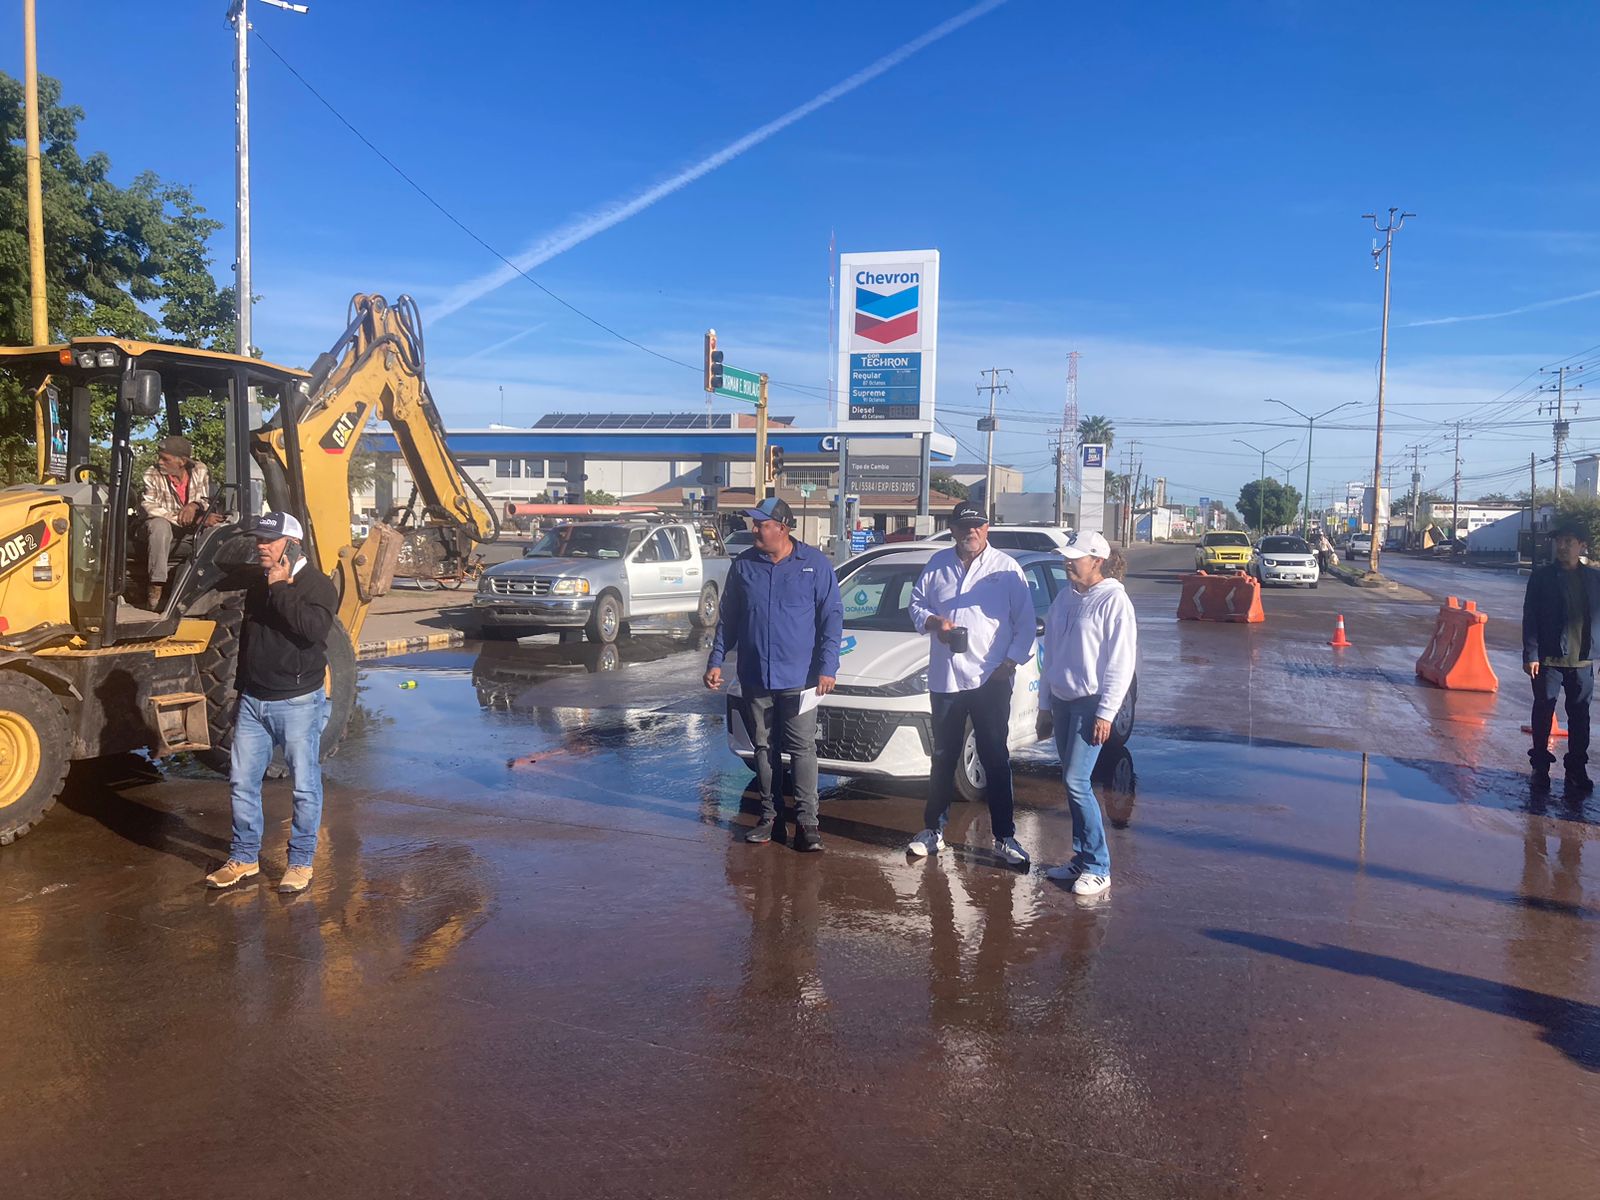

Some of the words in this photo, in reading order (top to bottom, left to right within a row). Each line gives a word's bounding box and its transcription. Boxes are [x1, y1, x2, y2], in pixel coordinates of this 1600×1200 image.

[856, 271, 919, 285] Chevron
[861, 357, 909, 368] TECHRON
[853, 372, 881, 380] Regular
[853, 389, 886, 398] Supreme
[852, 406, 875, 414] Diesel
[332, 413, 354, 447] CAT
